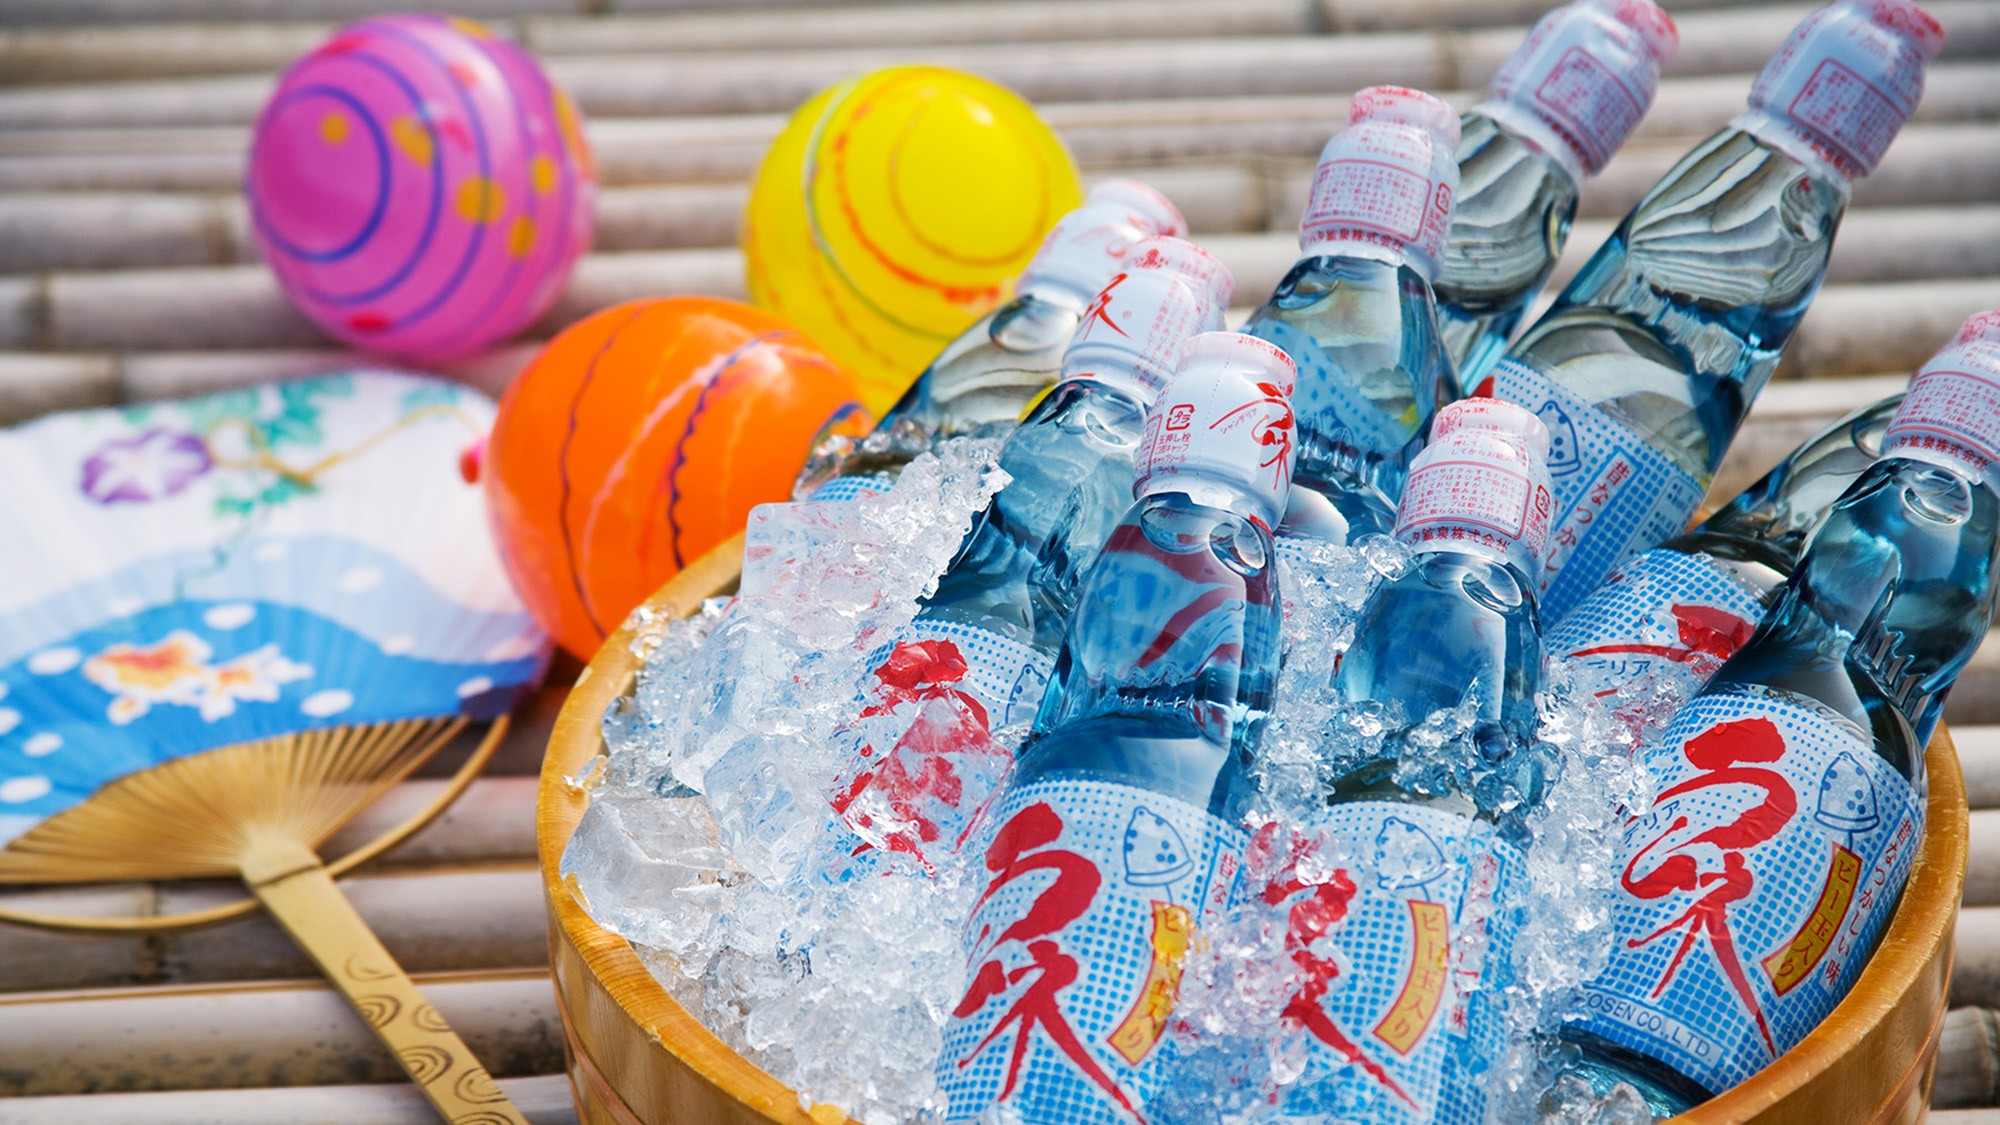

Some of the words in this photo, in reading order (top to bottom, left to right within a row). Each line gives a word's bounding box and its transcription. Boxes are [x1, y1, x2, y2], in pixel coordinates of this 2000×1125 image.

[1173, 410, 1191, 425] プラ
[1219, 407, 1257, 435] シャンデリア
[1778, 858, 1856, 978] ビー玉入り
[1825, 816, 1912, 987] 昔なつかしい味
[1391, 908, 1441, 1039] ビー玉入り
[1586, 991, 1637, 1021] OSEN
